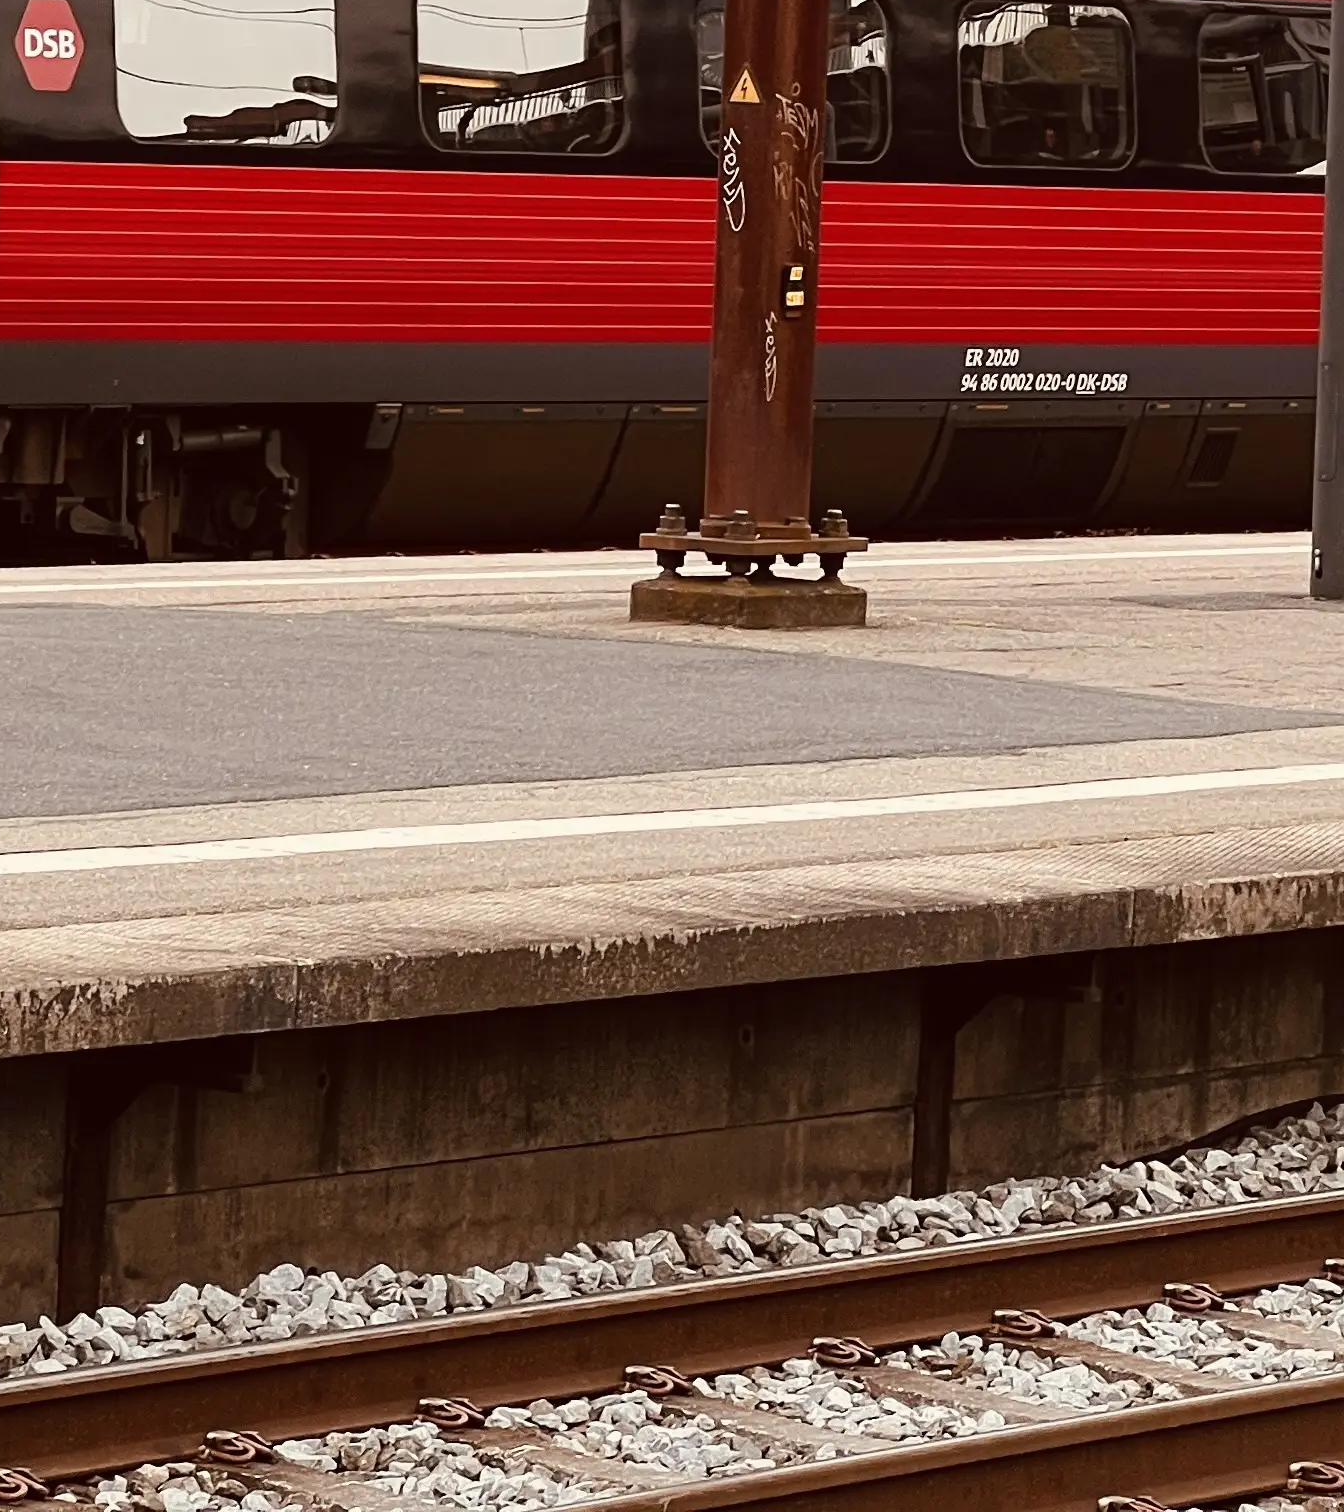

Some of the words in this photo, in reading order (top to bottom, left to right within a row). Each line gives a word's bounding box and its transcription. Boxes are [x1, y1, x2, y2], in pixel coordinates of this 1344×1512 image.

[24, 28, 76, 59] DSB
[965, 348, 984, 367] ER
[985, 349, 1020, 367] 2020
[960, 374, 978, 392] 94
[980, 374, 998, 392] 86
[1000, 374, 1034, 392] 0002
[1035, 374, 1076, 392] 020-0
[1076, 374, 1128, 394] DK-DSB
